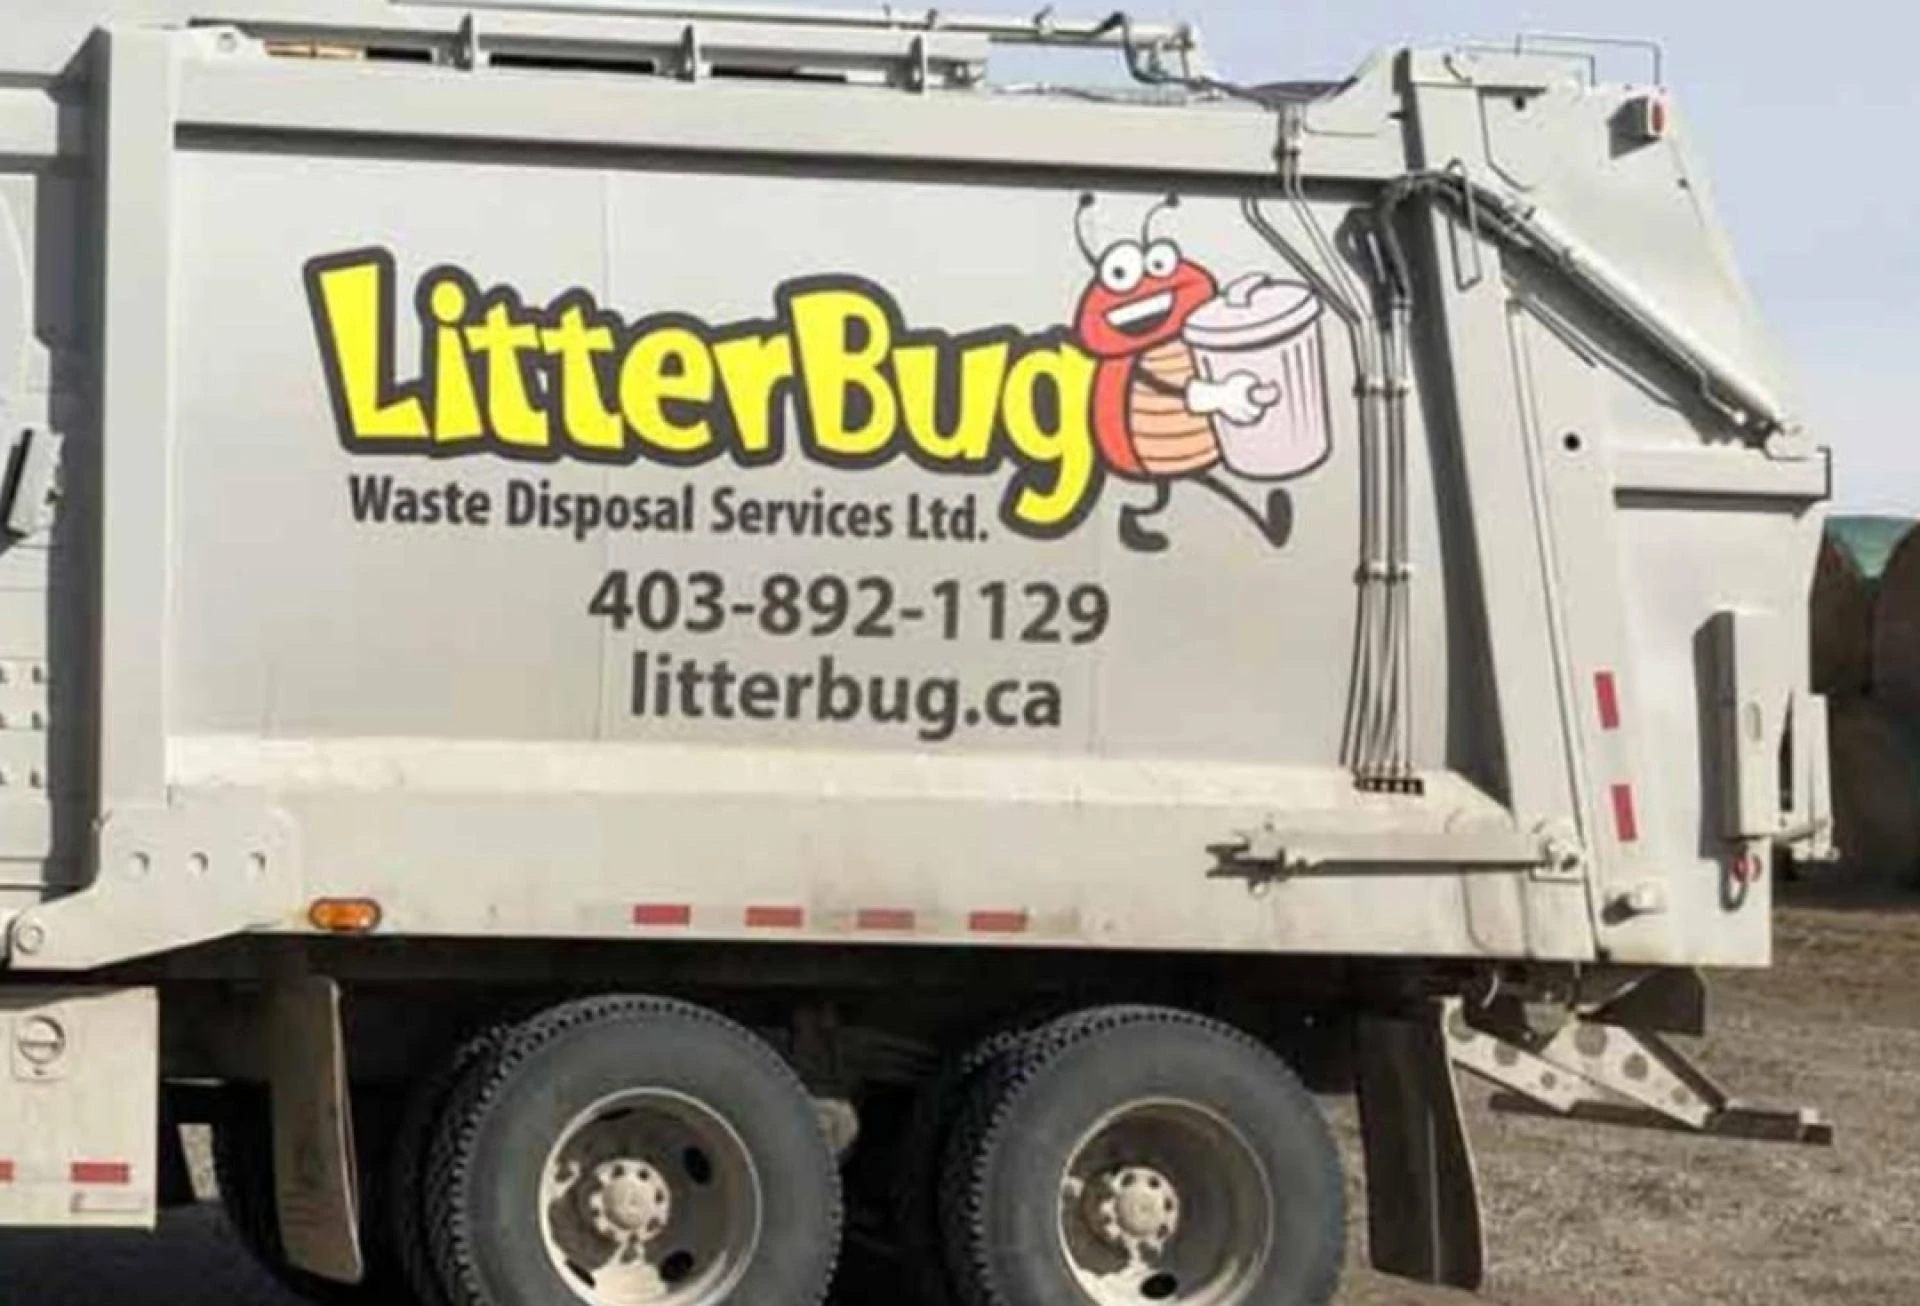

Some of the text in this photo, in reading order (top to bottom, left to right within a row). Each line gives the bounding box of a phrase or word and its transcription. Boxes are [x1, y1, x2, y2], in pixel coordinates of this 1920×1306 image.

[310, 254, 1097, 530] LitterBug
[348, 475, 989, 542] Waste Disposal Services Ltd.
[587, 569, 1110, 645] 403-892-1129
[631, 650, 1062, 743] litterbug.ca
